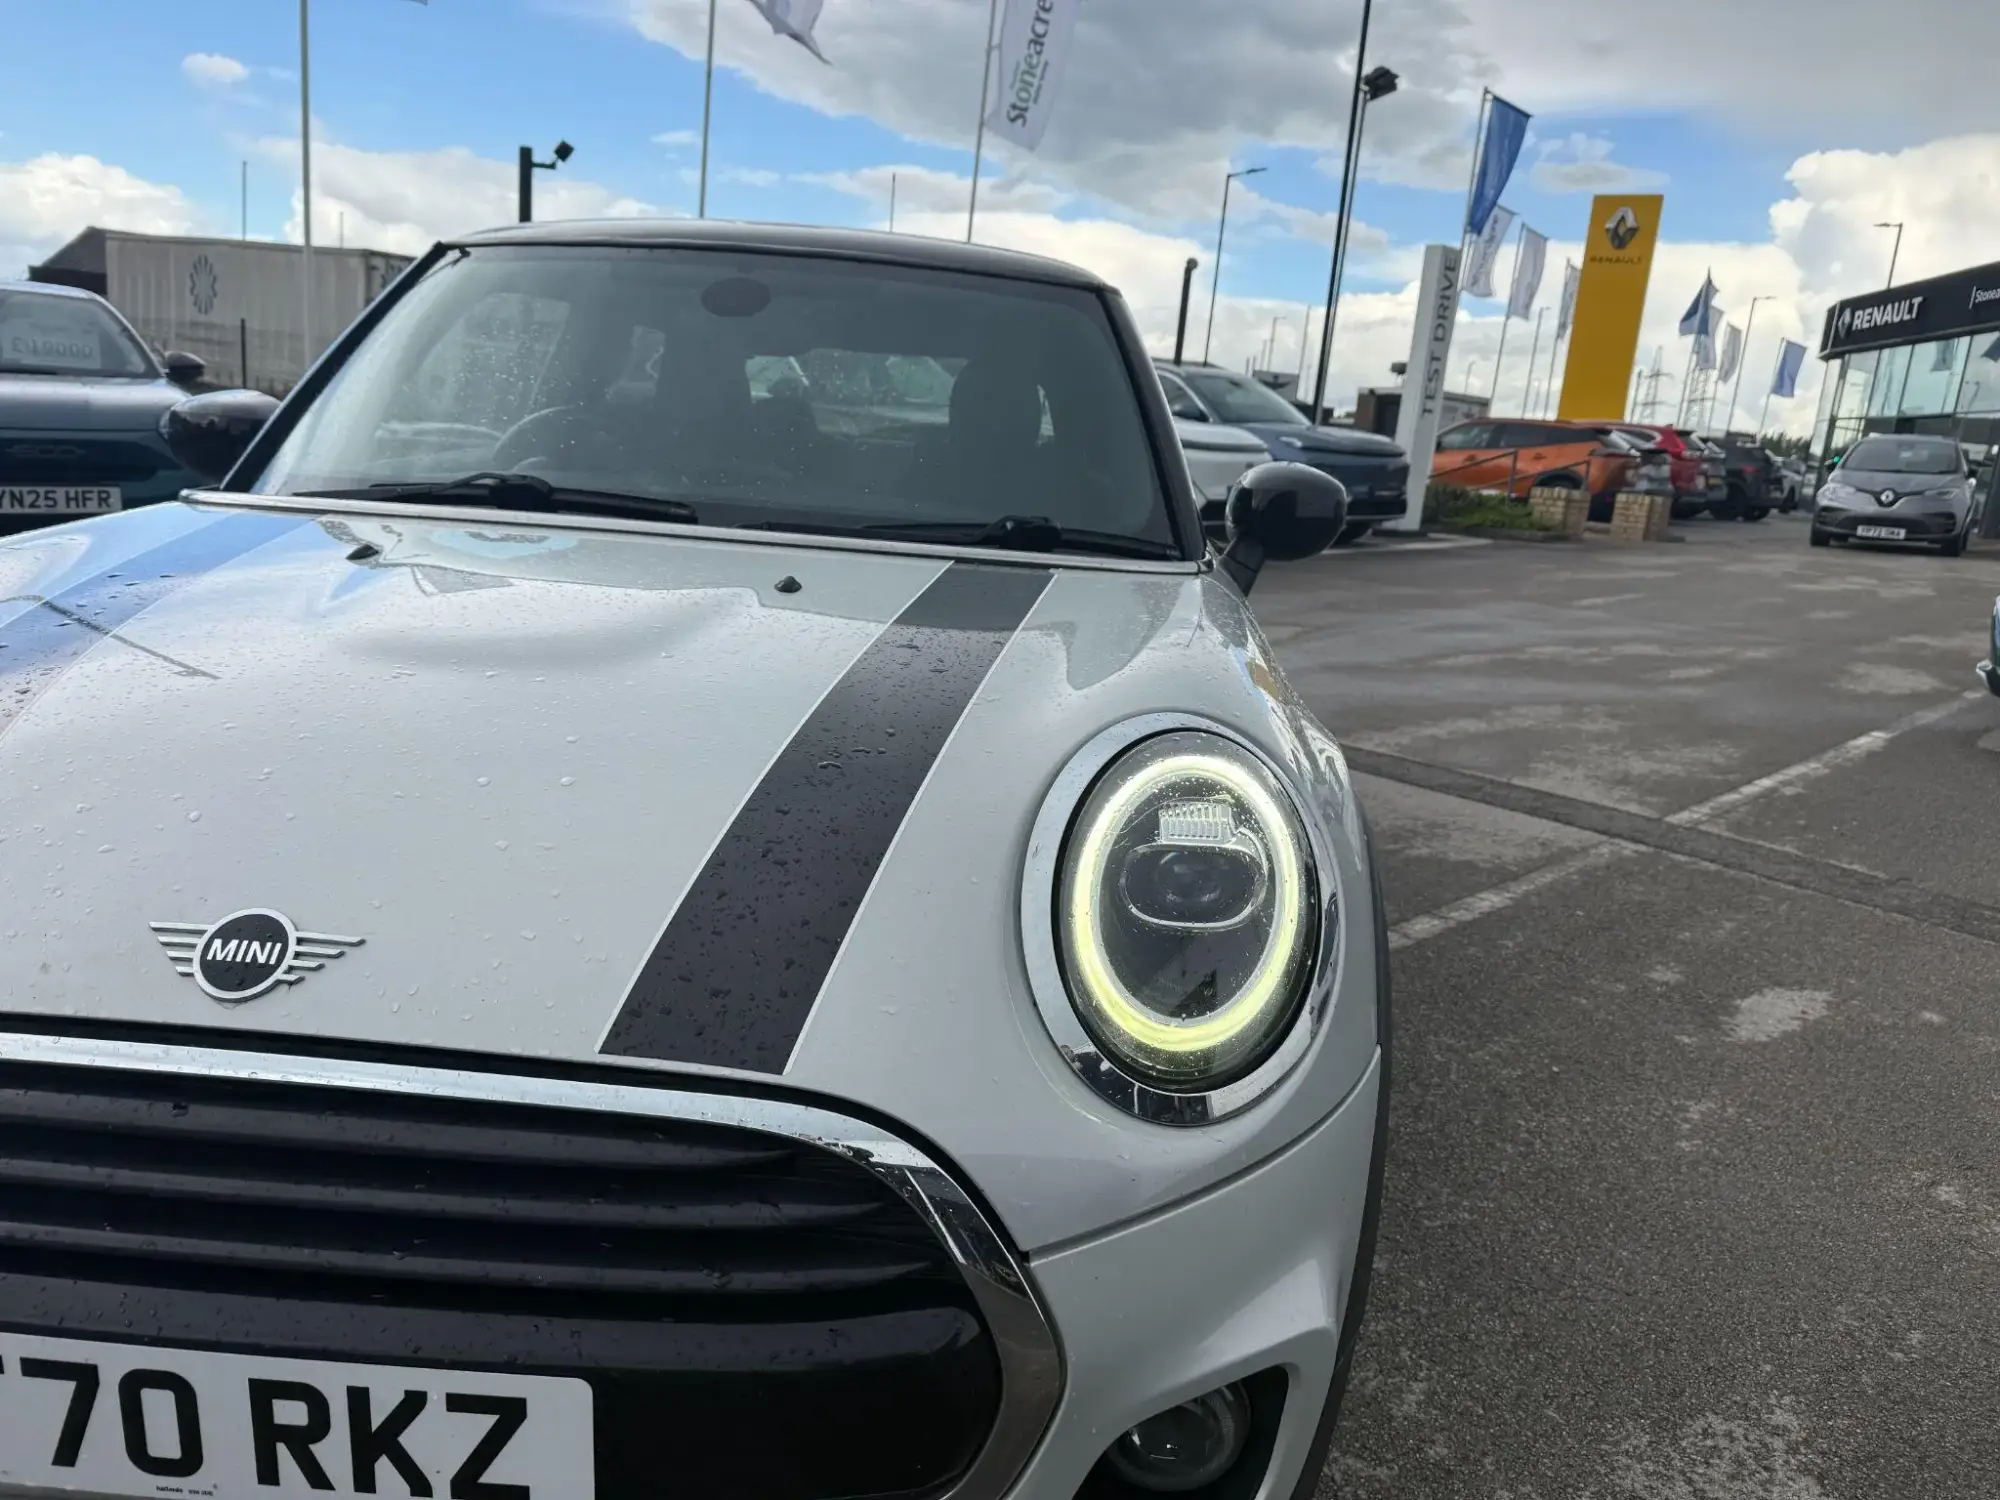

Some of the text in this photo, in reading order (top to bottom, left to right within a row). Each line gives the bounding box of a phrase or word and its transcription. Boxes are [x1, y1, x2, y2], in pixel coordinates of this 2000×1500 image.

[1006, 0, 1053, 127] Stoneacre
[1422, 256, 1457, 418] TEST DRIVE
[1852, 296, 1924, 331] RENAULT
[65, 489, 111, 509] HFR
[207, 938, 282, 965] MINI
[0, 1355, 532, 1500] 70 RKZ
